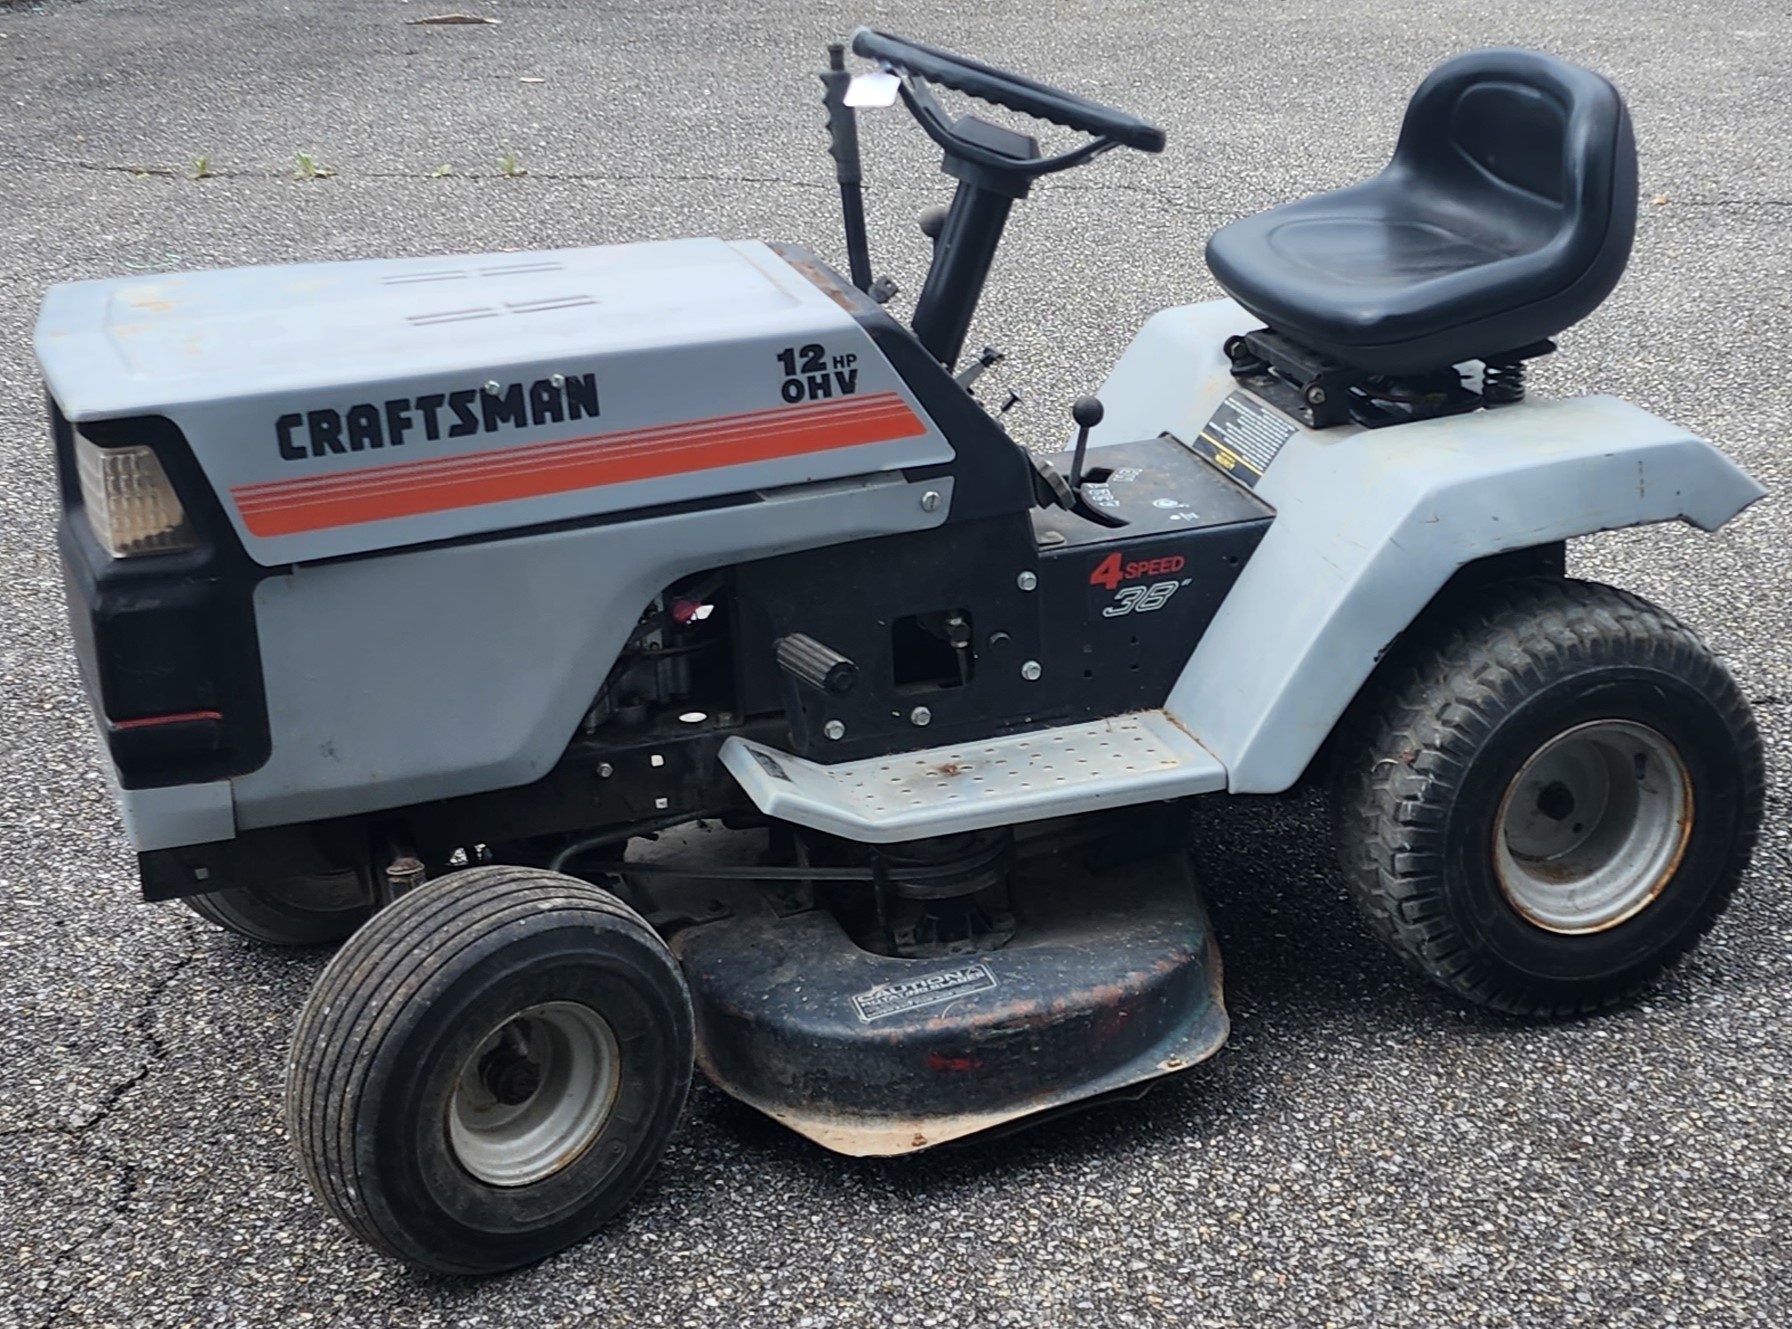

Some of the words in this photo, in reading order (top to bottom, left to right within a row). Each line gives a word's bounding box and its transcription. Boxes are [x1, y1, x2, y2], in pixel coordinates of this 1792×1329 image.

[777, 344, 827, 376] 12
[832, 354, 857, 369] HP
[781, 368, 858, 404] OHV
[275, 373, 600, 461] CRAFTSMAN
[1090, 552, 1123, 590] 4
[1124, 556, 1185, 579] SPEED
[857, 971, 963, 1002] CAUTION
